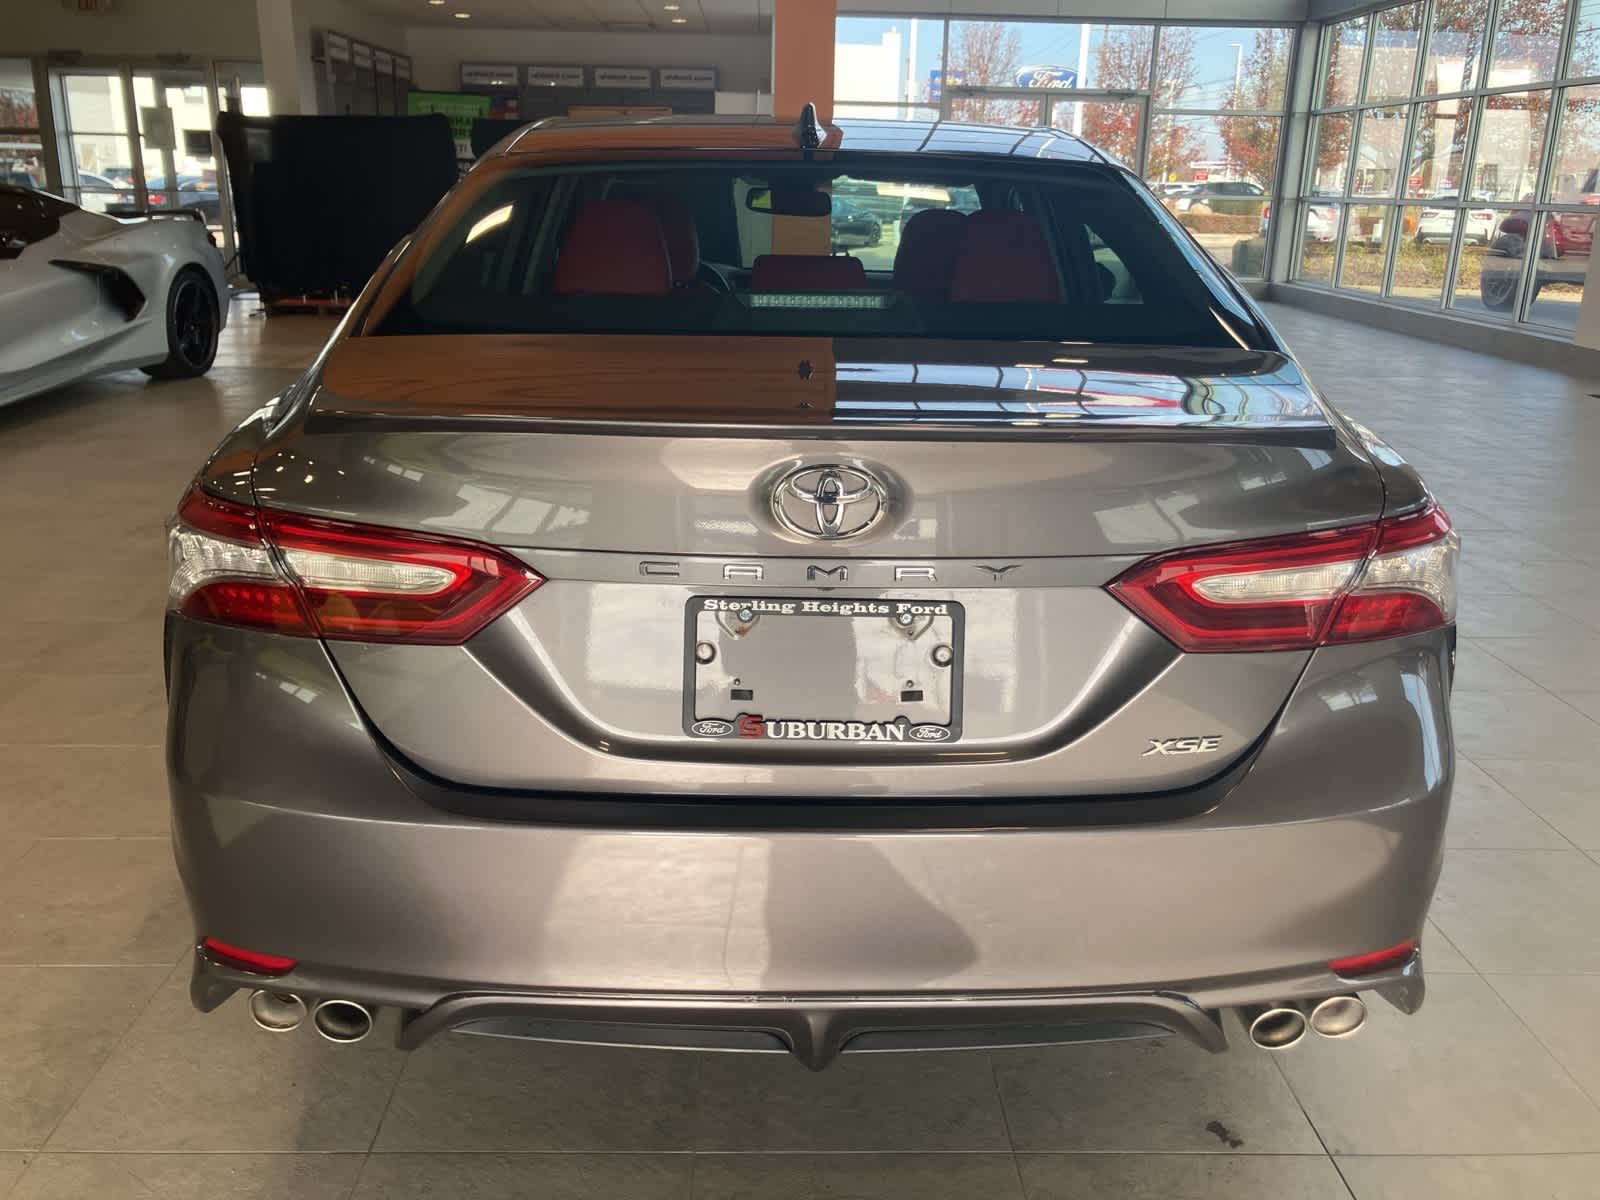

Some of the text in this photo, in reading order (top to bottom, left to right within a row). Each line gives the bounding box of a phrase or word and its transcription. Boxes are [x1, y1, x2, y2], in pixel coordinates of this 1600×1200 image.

[1028, 71, 1075, 88] Ford
[639, 560, 1023, 582] CAMRY
[703, 599, 948, 615] Sterling Heights Ford
[699, 721, 726, 734] Ford
[738, 715, 905, 741] SUBURBAN
[916, 727, 942, 738] Ford
[1141, 735, 1223, 757] XSE
